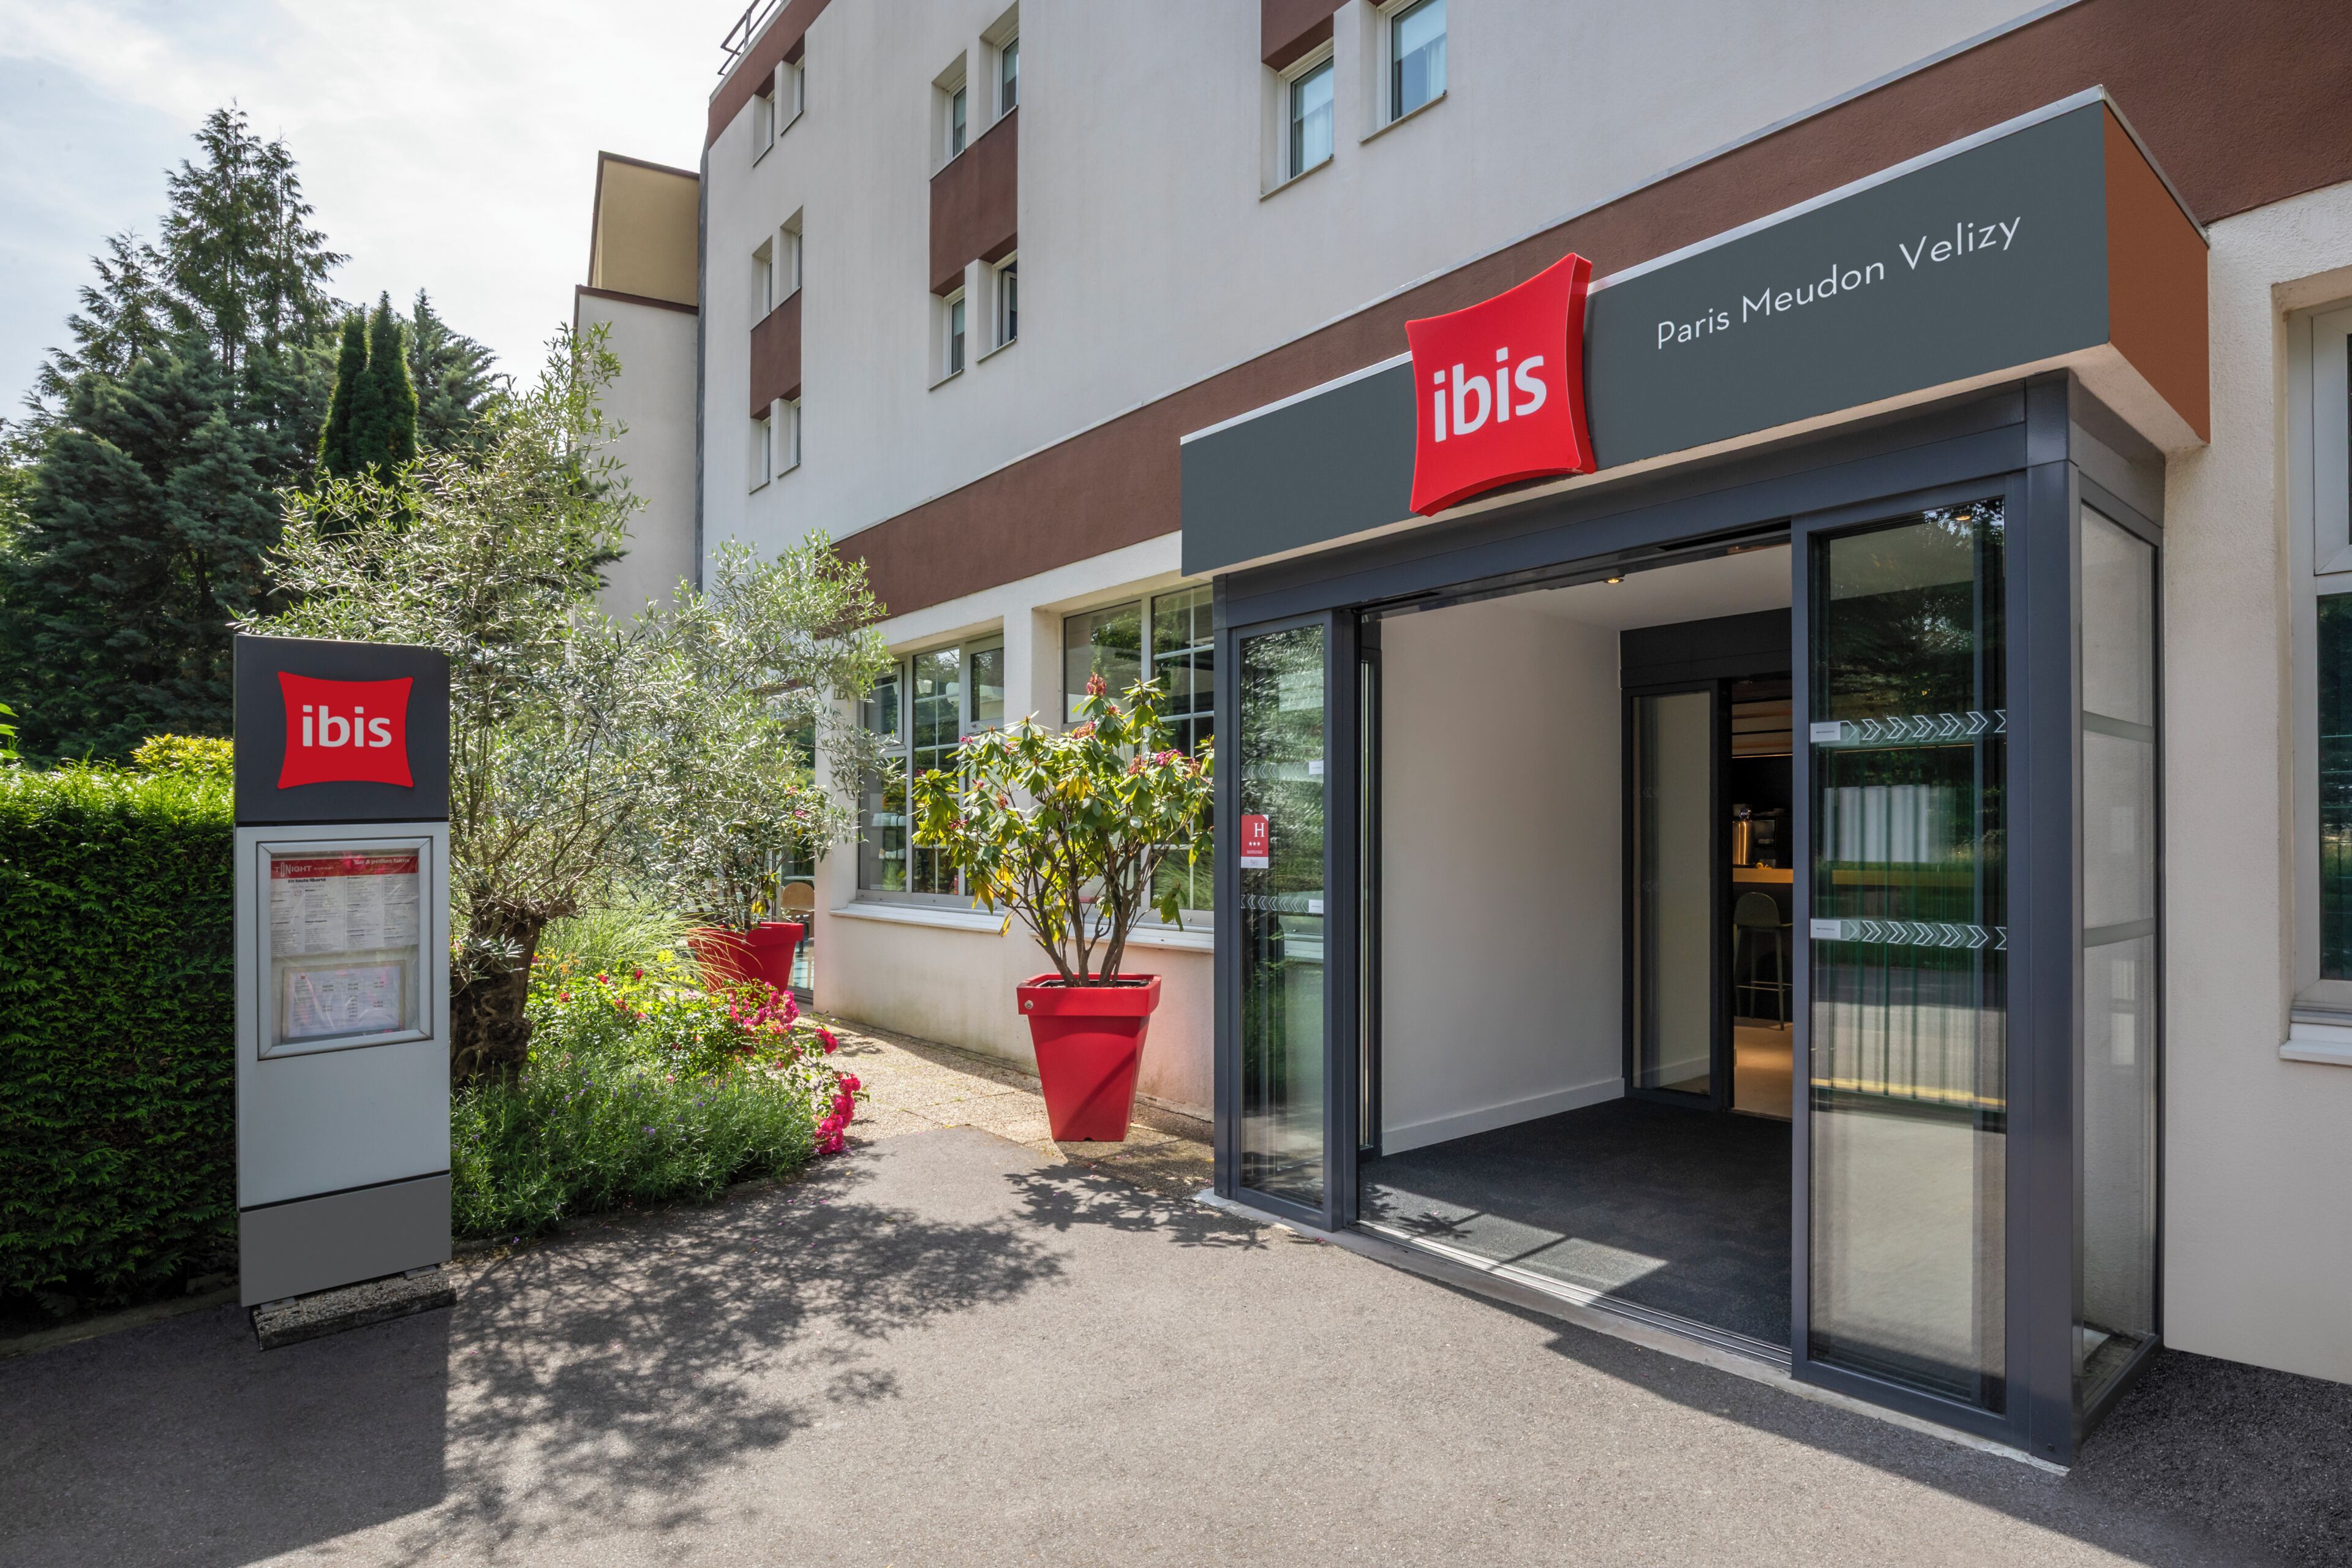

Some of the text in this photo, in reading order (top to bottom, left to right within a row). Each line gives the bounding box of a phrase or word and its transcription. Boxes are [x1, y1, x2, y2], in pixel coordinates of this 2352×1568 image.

[1657, 216, 2021, 350] Paris Meudon Velizy
[1434, 347, 1547, 442] ibis
[303, 705, 392, 748] ibis
[1254, 823, 1265, 837] H
